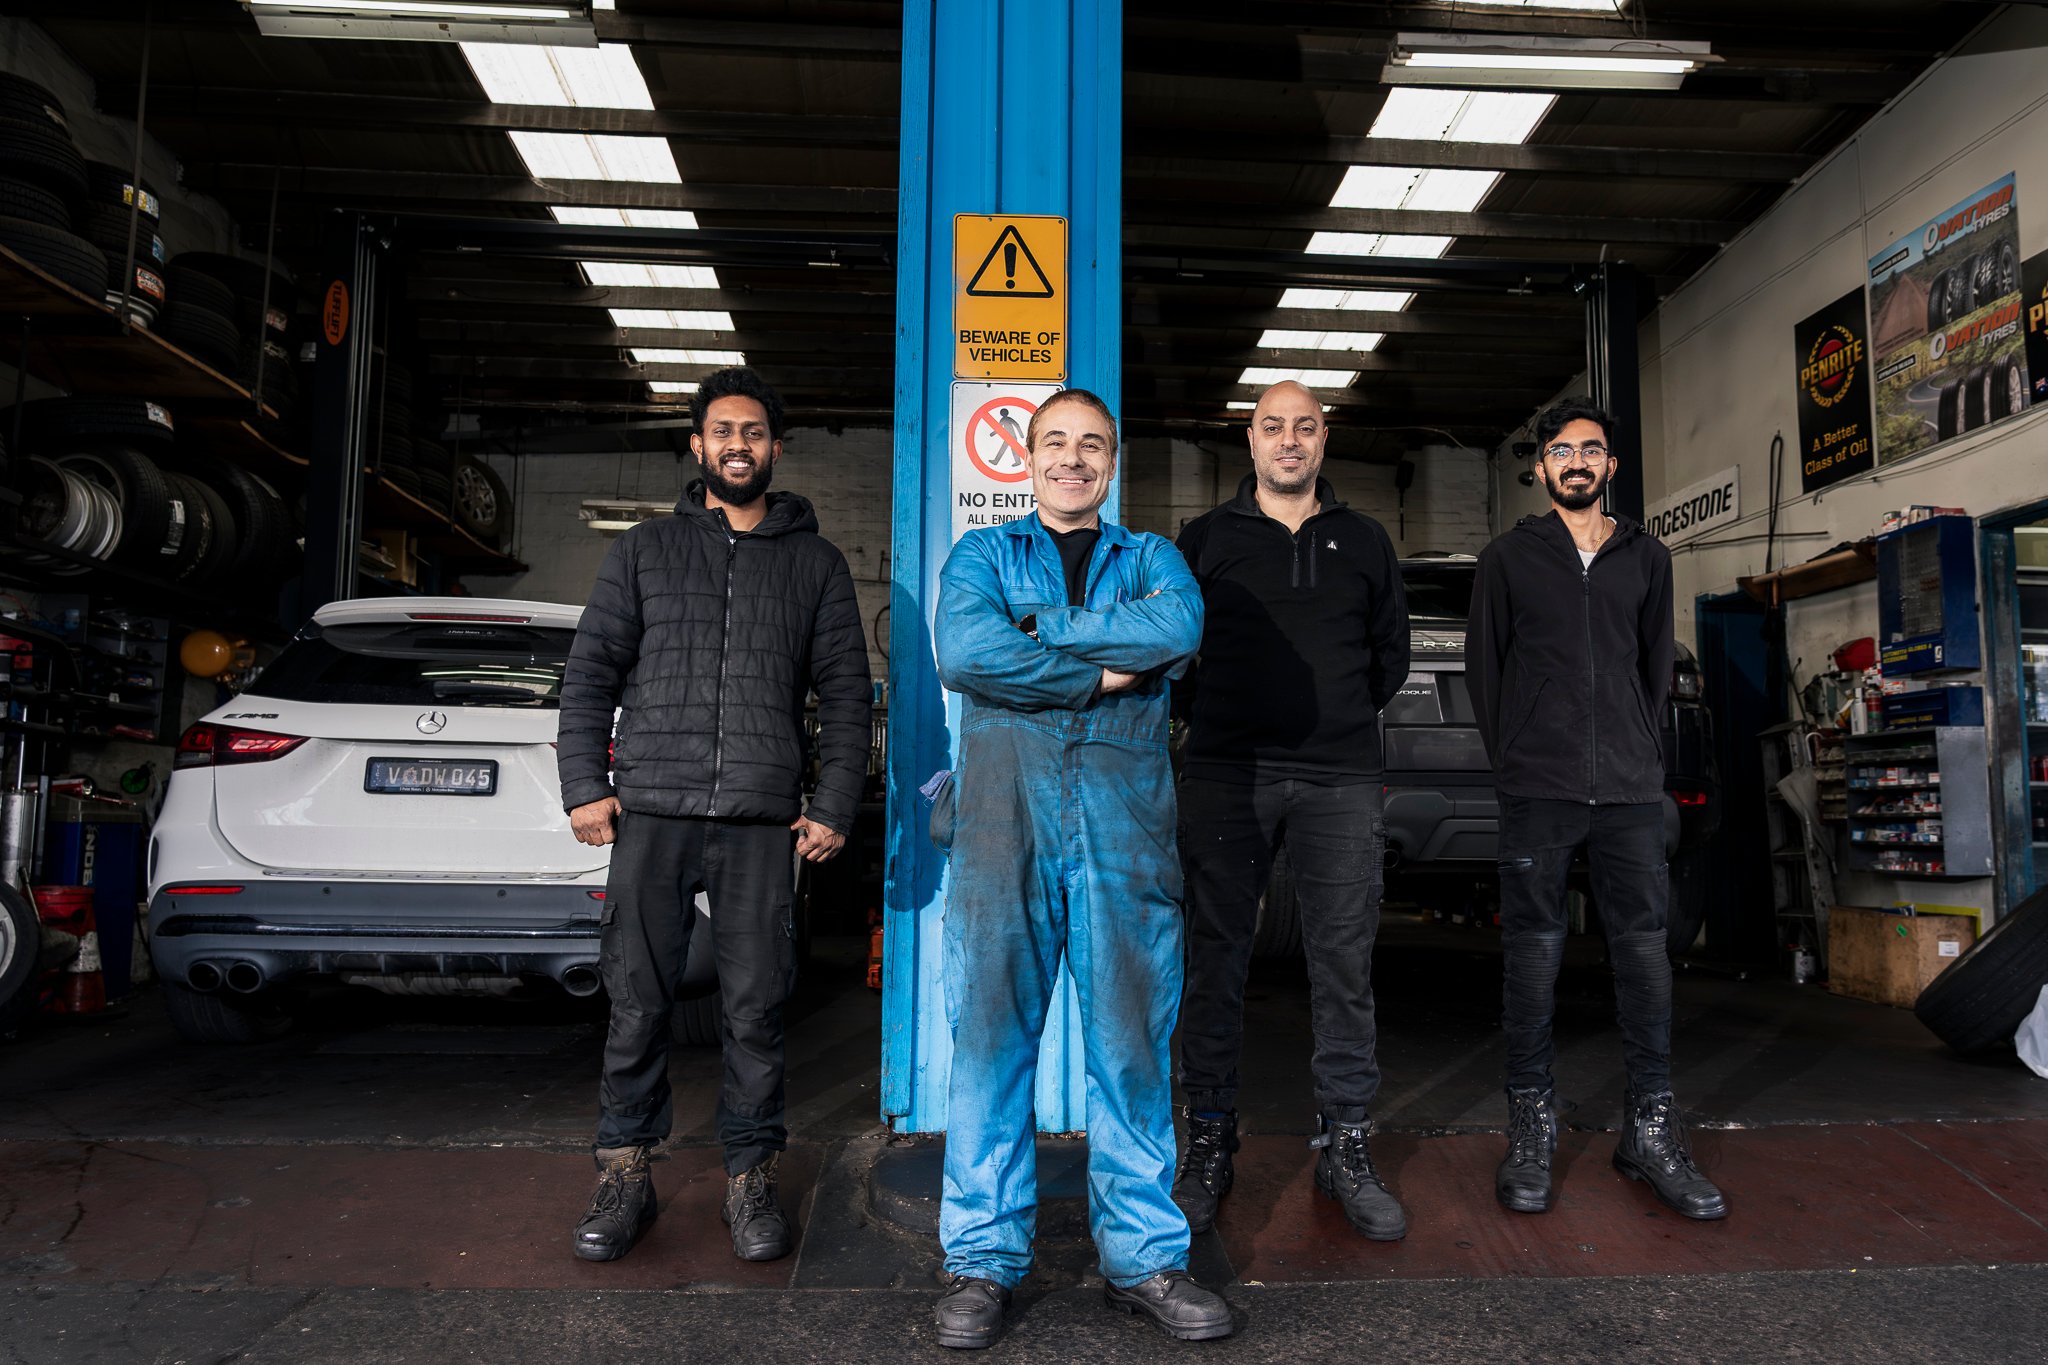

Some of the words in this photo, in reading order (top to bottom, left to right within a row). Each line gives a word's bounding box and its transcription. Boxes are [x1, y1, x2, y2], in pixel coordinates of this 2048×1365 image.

[1923, 184, 2014, 251] OVATION
[1972, 203, 2011, 233] TYRES
[960, 330, 1031, 345] BEWARE
[1037, 332, 1060, 345] OF
[1930, 301, 2022, 361] OVATION
[1980, 320, 2018, 347] TYRES
[969, 348, 1051, 363] VEHICLES
[1801, 338, 1864, 390] PENRITE
[1812, 437, 1821, 452] A
[1824, 423, 1859, 446] Better
[1805, 455, 1833, 476] Class
[1835, 446, 1848, 463] of
[1850, 437, 1869, 457] Oil
[959, 492, 987, 508] NO
[967, 514, 988, 525] ALL
[451, 768, 491, 790] 045
